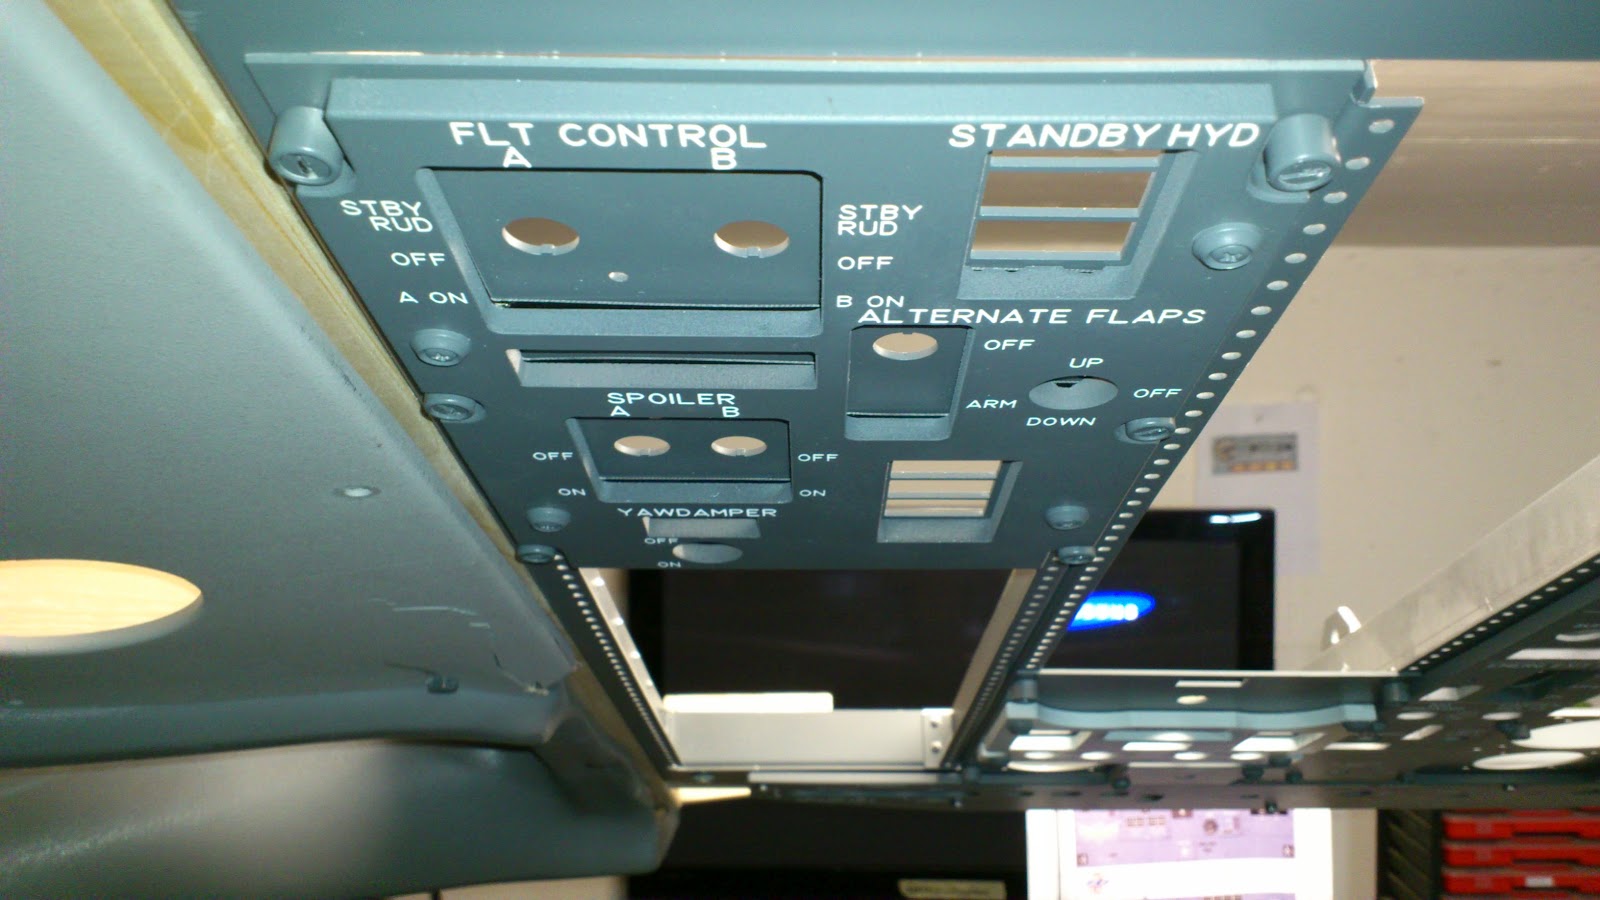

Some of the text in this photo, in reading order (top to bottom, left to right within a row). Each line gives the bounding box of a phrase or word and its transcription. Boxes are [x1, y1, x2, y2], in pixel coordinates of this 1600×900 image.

[450, 121, 767, 149] FLT CONTROL
[948, 122, 1261, 148] STANDBY HYD
[502, 146, 533, 168] A
[710, 148, 738, 170] B
[339, 200, 422, 216] STBY
[838, 204, 923, 222] STBY
[369, 216, 434, 233] RUD
[837, 221, 898, 237] RUD
[390, 252, 445, 267] OFF
[837, 255, 894, 271] OFF
[399, 290, 469, 305] A ON
[836, 294, 905, 308] B ON
[857, 309, 1206, 325] ALTERNATE FLAPS
[983, 338, 1036, 351] OFF
[1069, 357, 1104, 369] UP
[607, 392, 736, 405] SPOILER
[1133, 388, 1183, 399] OFF
[965, 399, 1018, 409] ARM
[610, 405, 631, 417] A
[721, 405, 741, 418] B
[1026, 416, 1097, 427] DOWN
[532, 451, 573, 461] OFF
[797, 453, 839, 462] OFF
[557, 487, 586, 497] ON
[799, 489, 826, 497] ON
[644, 537, 679, 545] OFF
